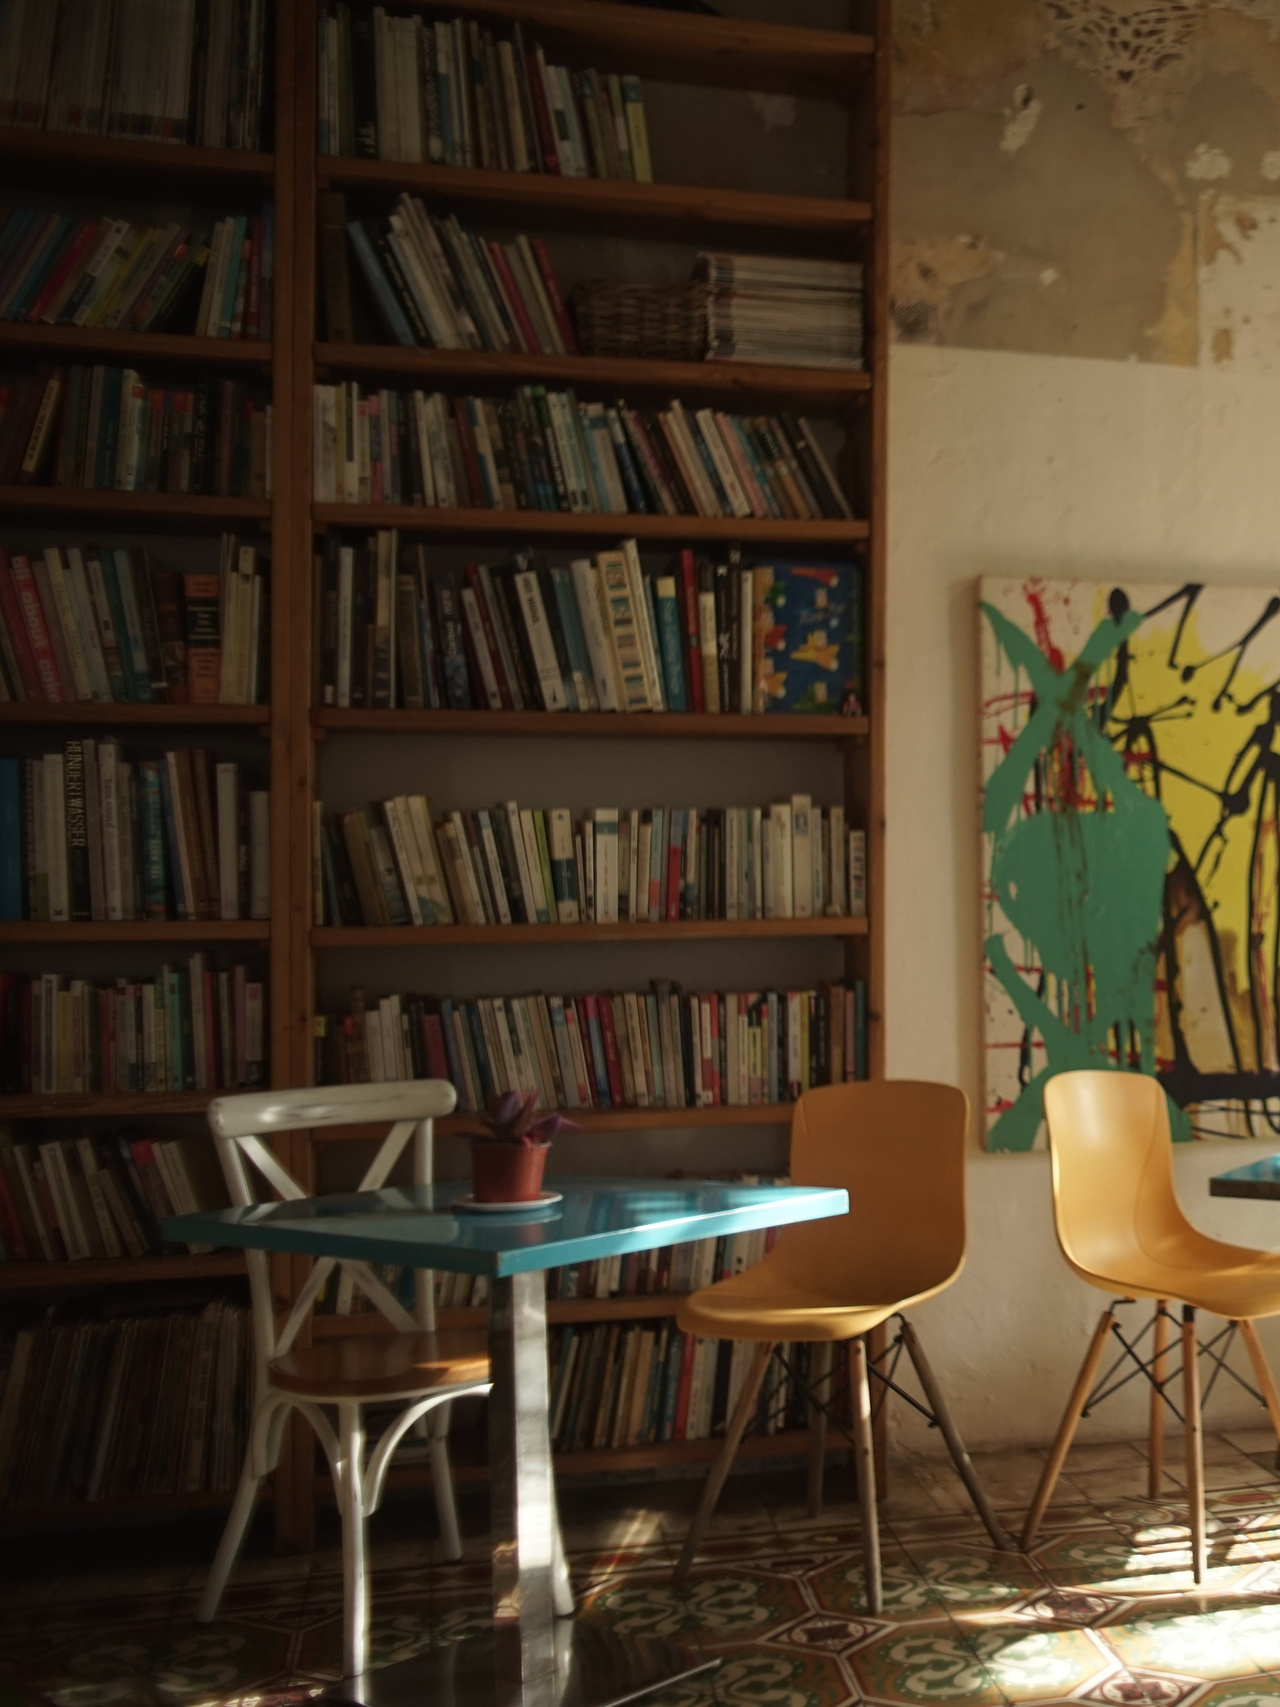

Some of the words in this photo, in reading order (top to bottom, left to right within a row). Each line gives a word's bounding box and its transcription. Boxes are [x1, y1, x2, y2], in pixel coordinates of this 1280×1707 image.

[12, 557, 32, 580] all
[20, 591, 48, 649] about
[41, 660, 62, 702] cake
[65, 740, 87, 847] HUNDERTWASSER
